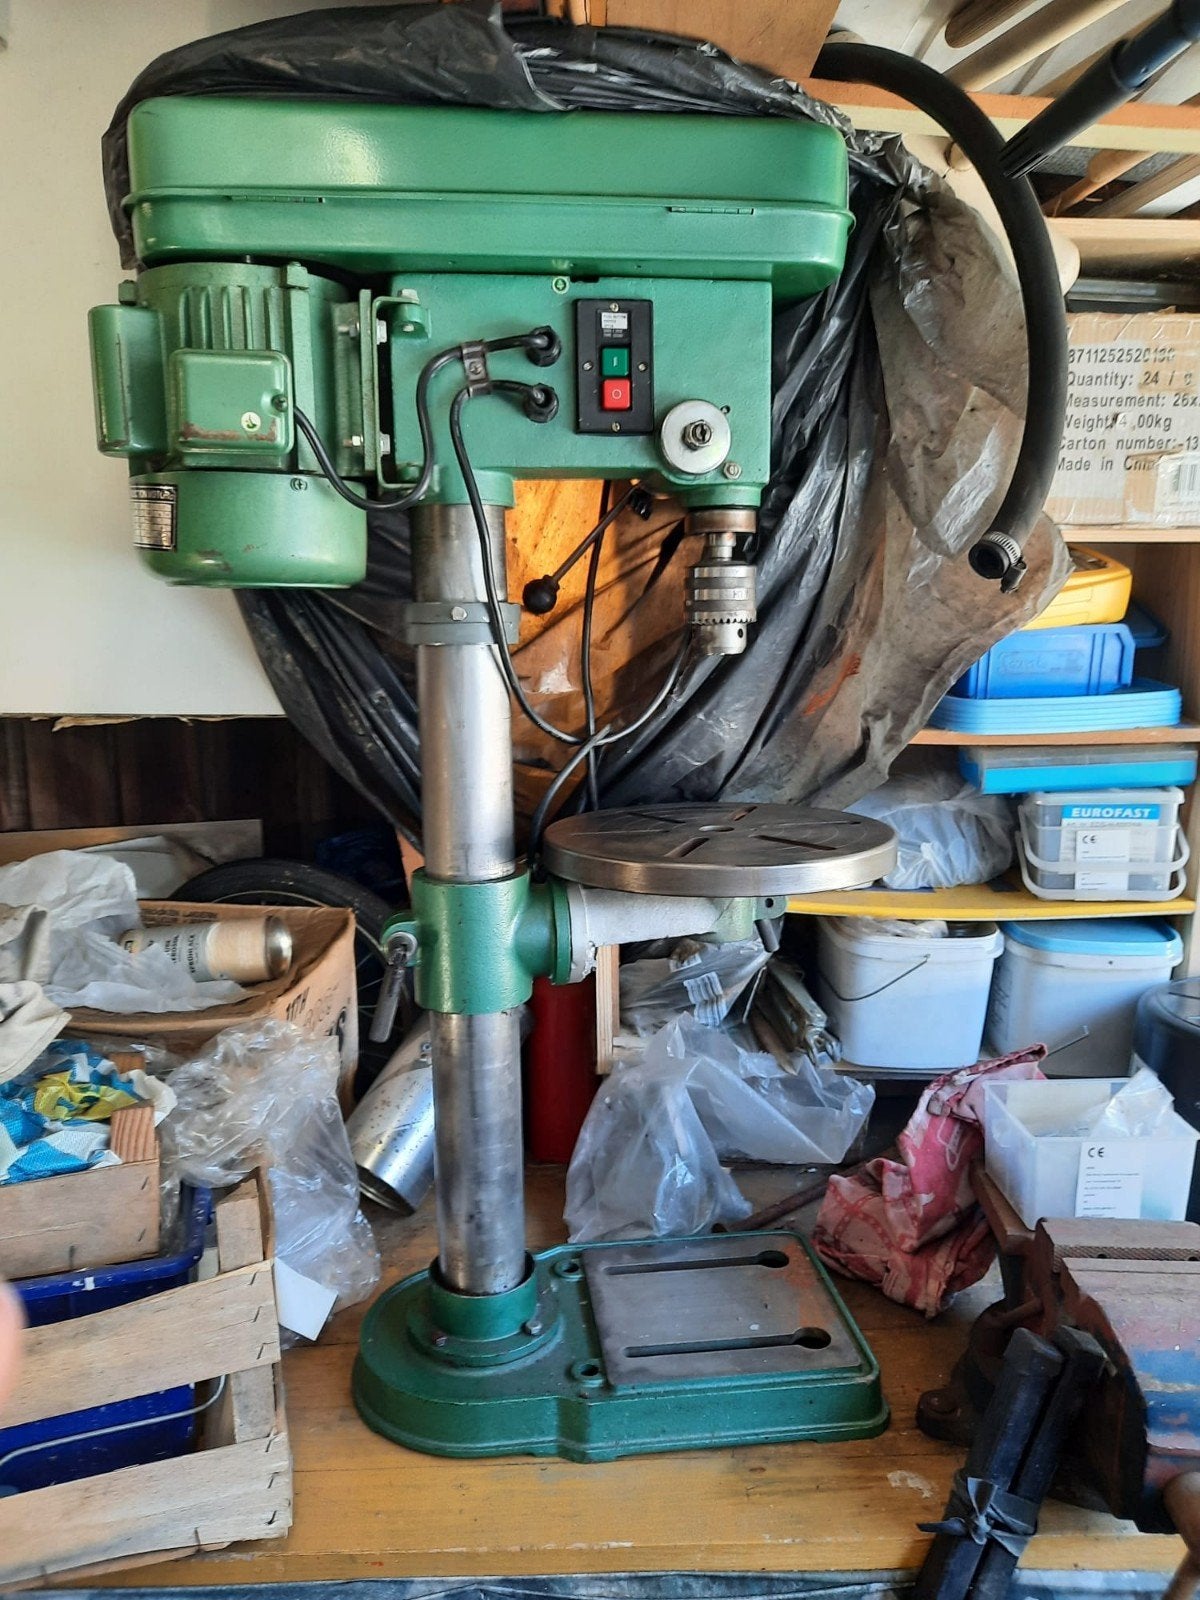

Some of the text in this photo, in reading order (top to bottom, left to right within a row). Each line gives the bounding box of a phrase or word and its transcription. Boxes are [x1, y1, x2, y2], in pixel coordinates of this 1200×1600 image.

[1067, 371, 1134, 389] Quantity:
[1142, 371, 1159, 385] 24
[1173, 392, 1200, 407] 26x
[1101, 456, 1113, 471] in
[1071, 808, 1151, 818] EUROFAST
